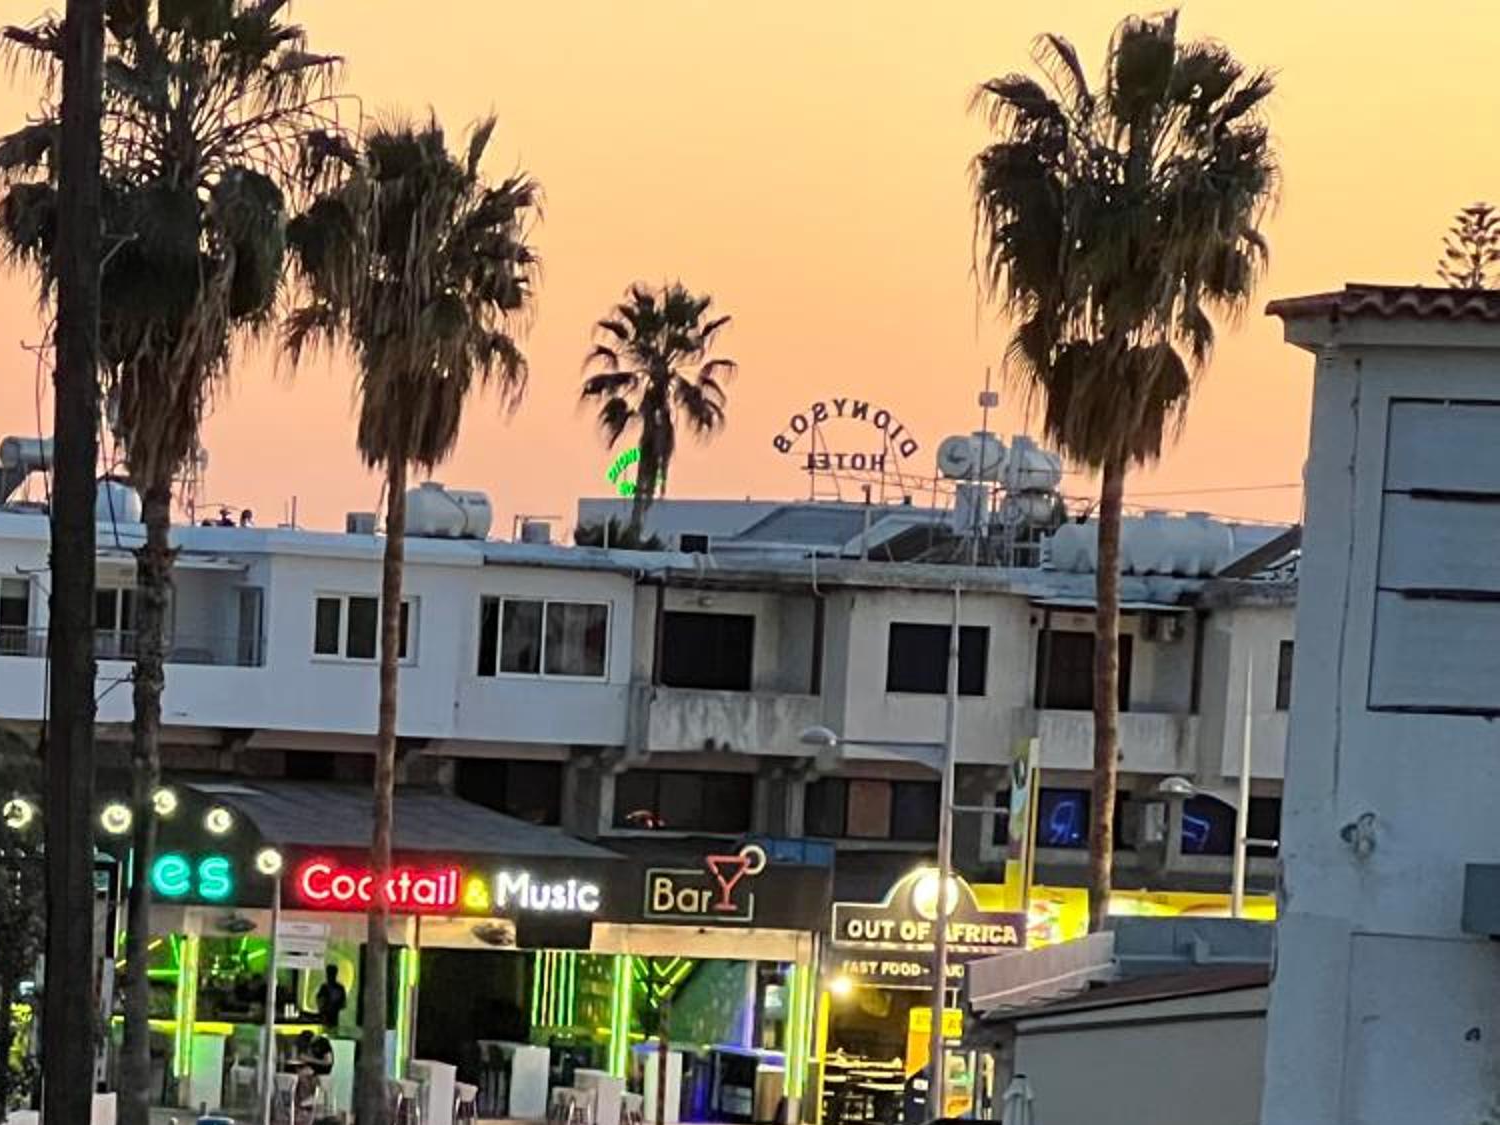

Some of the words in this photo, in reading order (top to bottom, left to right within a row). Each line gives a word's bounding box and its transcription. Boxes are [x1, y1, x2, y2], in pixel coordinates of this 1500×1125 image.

[464, 877, 489, 910] &
[496, 870, 600, 912] Music
[653, 877, 712, 913] Bar
[848, 919, 894, 939] OUT
[900, 921, 931, 941] OF
[881, 962, 921, 976] FOOD
